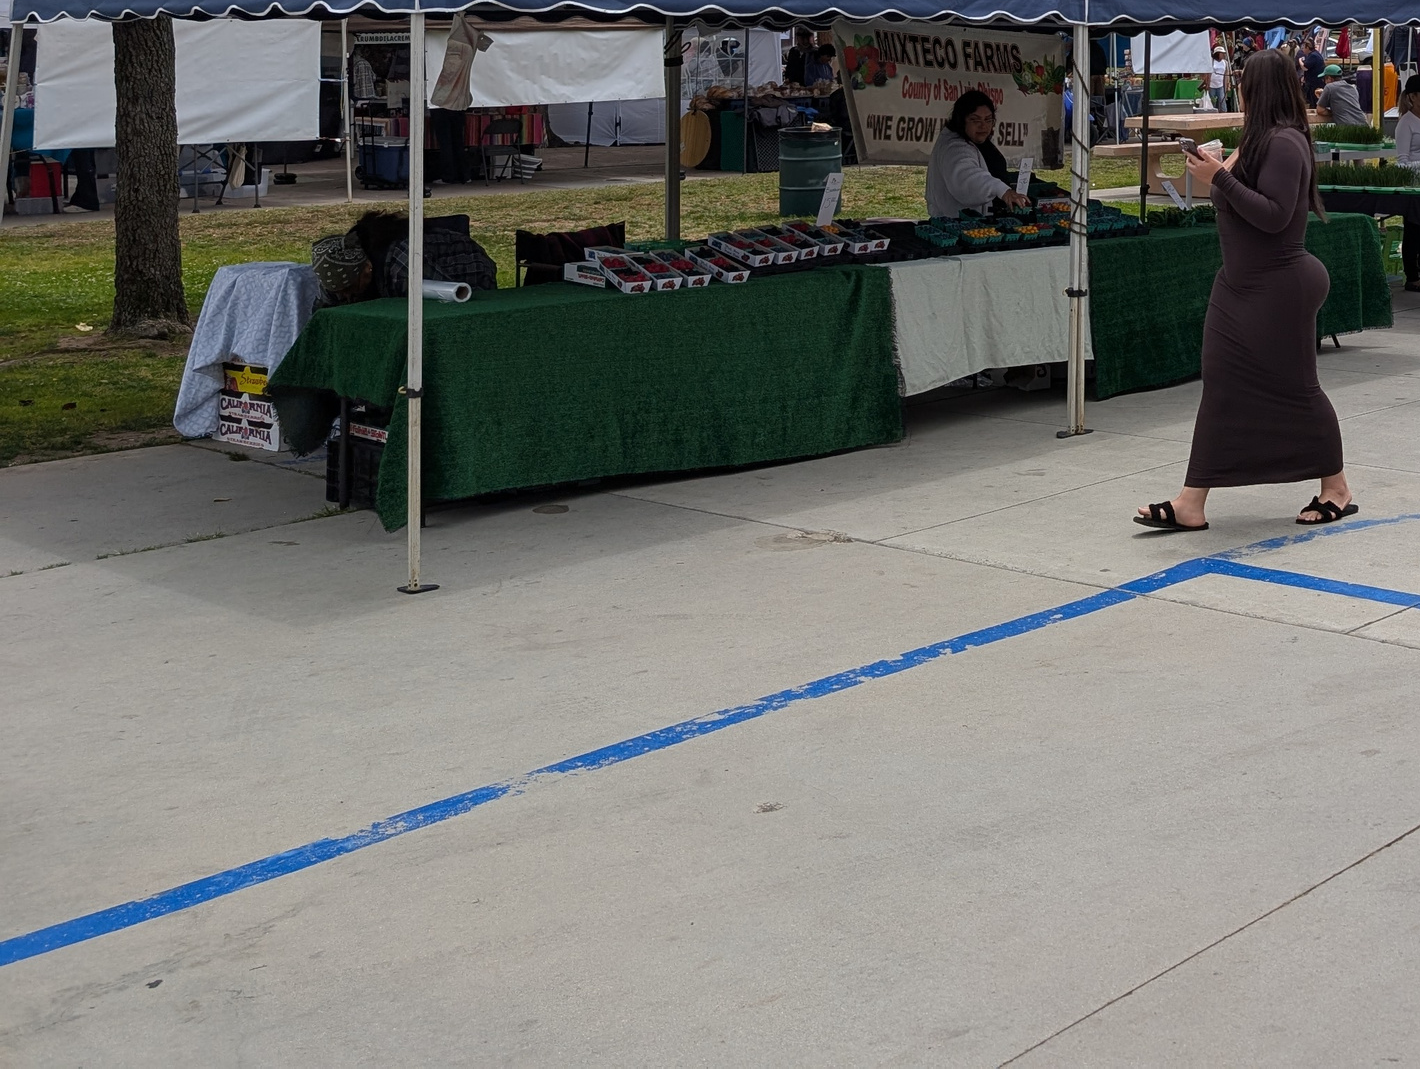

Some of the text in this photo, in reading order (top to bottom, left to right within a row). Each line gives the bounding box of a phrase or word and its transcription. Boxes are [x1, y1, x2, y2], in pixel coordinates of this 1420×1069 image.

[874, 30, 1023, 74] MIXTECO FARMS
[901, 75, 931, 106] County
[934, 78, 941, 100] of
[943, 78, 958, 101] San
[896, 115, 937, 143] GROW
[220, 397, 272, 420] CALIFORNIA
[220, 423, 272, 446] CALIFORNIA
